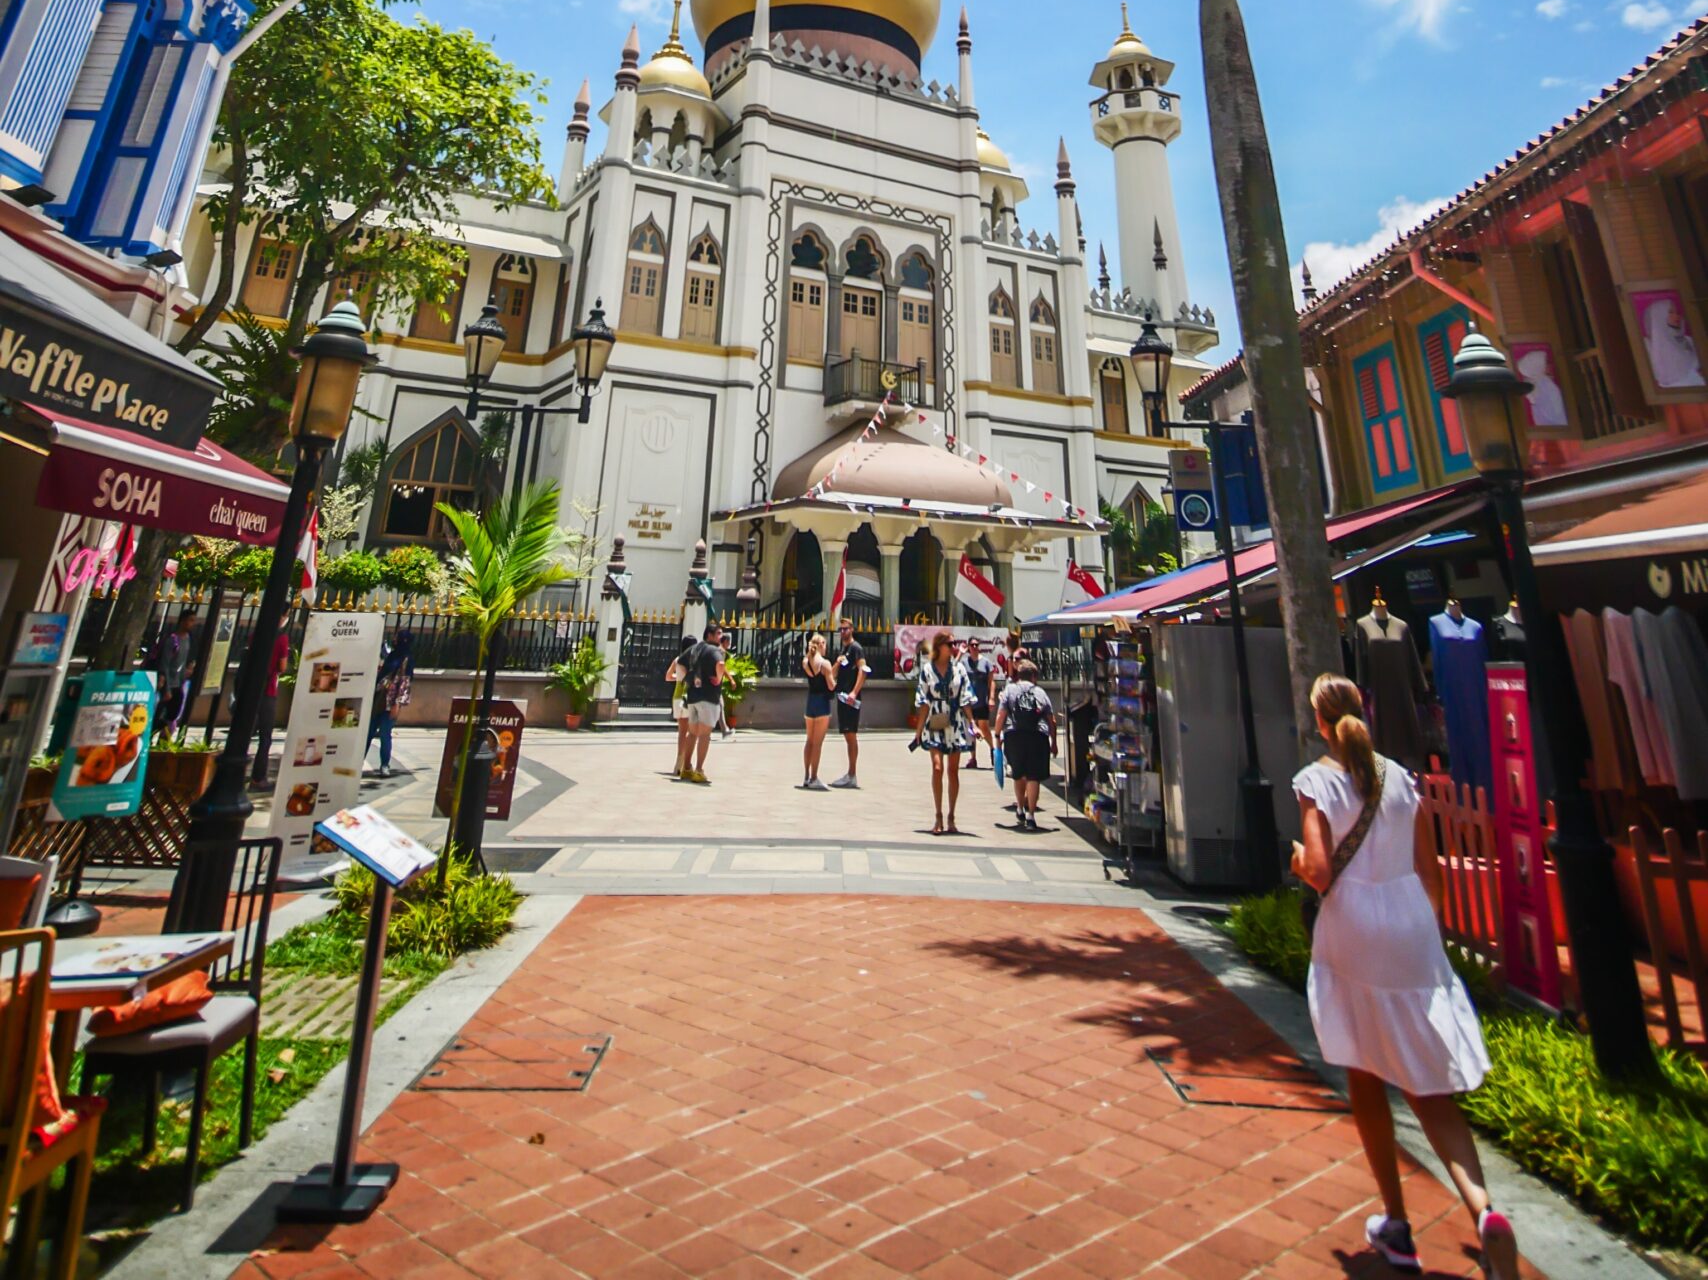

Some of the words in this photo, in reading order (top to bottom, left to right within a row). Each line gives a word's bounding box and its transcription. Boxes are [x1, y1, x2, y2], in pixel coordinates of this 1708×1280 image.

[91, 377, 169, 431] Place
[92, 468, 162, 518] SOHA
[209, 497, 237, 527] chai
[235, 509, 268, 536] queen
[336, 619, 357, 628] CHAI
[331, 628, 360, 637] QUEEN
[91, 691, 125, 703] PRAWN
[490, 716, 520, 727] CHAAT
